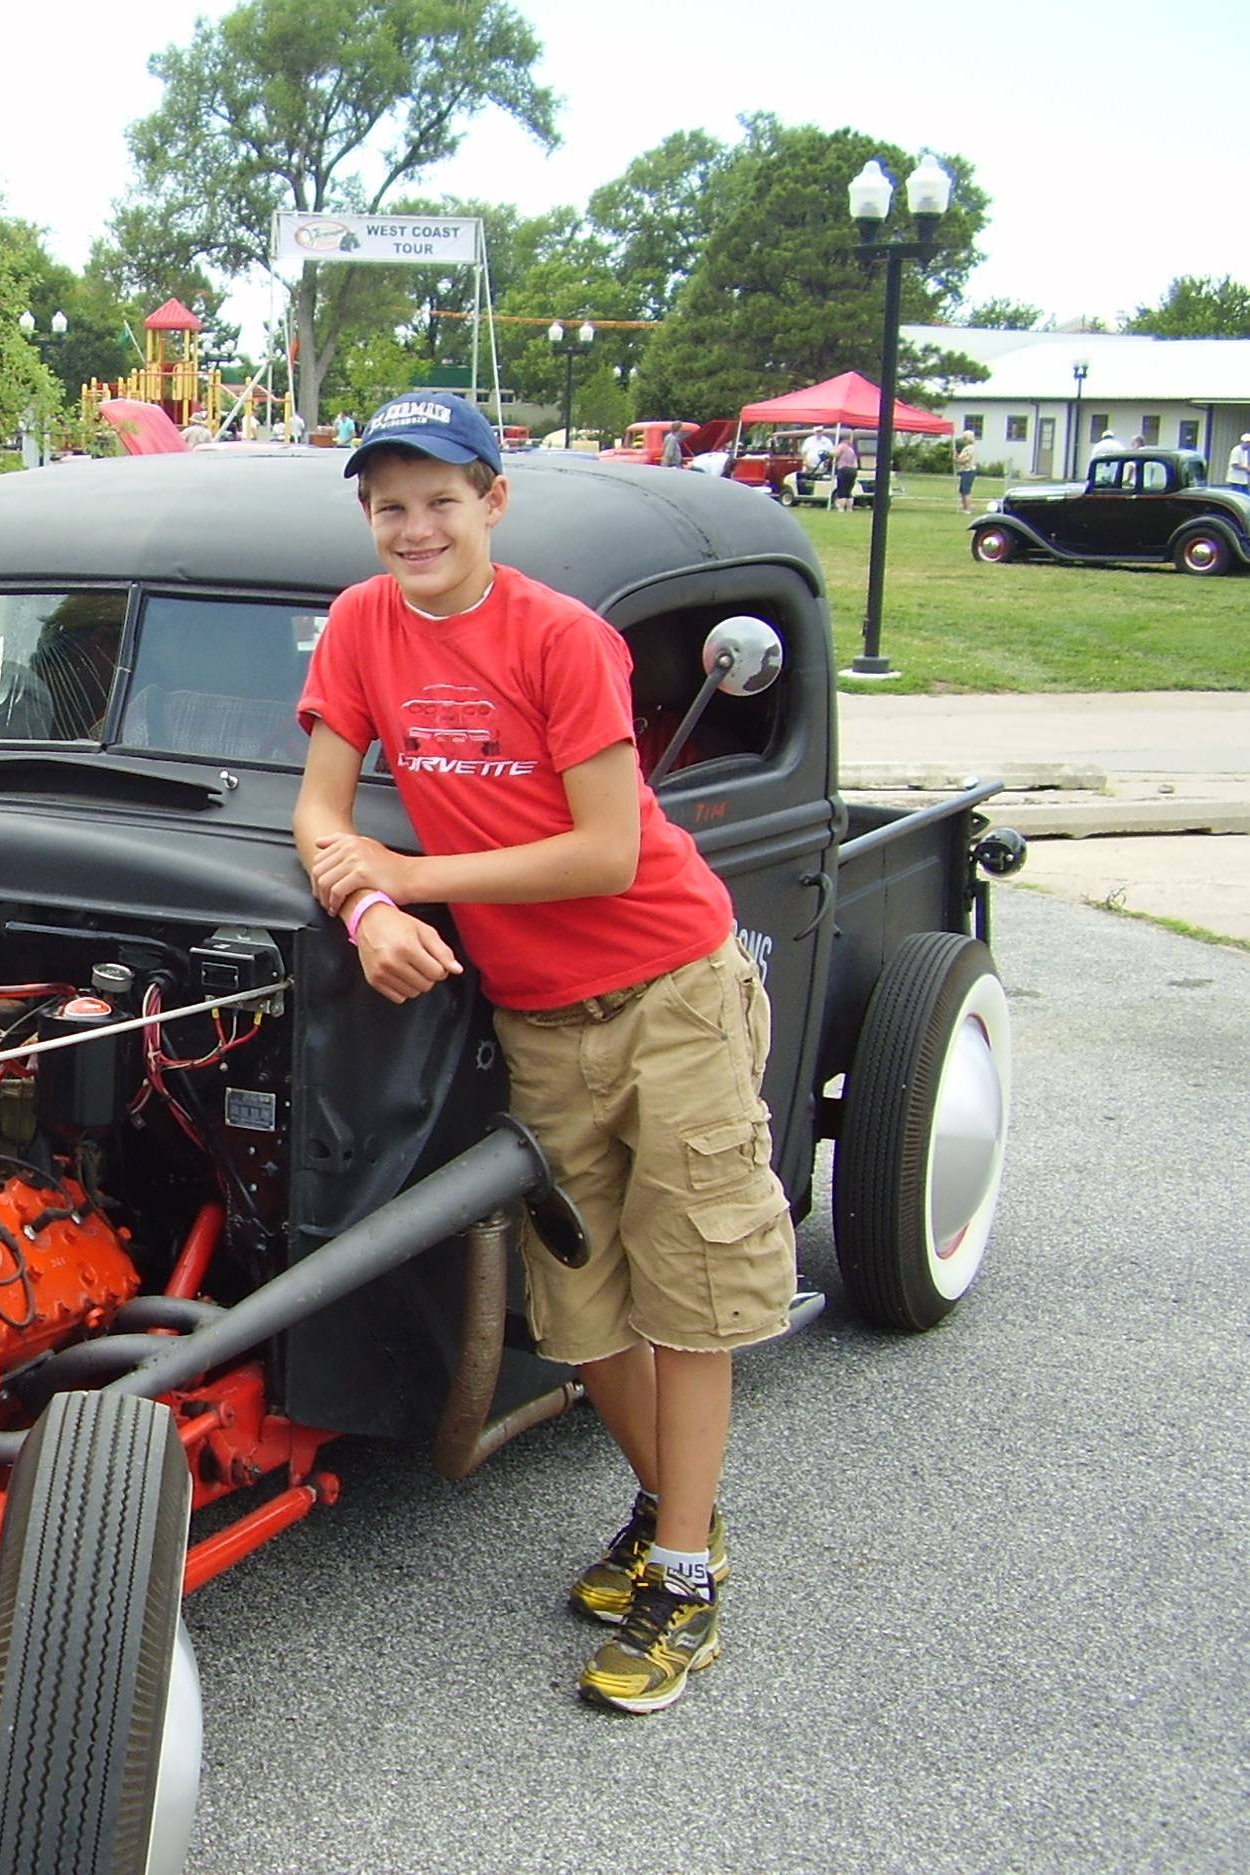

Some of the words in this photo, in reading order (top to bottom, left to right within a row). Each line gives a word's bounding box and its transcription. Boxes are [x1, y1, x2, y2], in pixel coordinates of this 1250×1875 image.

[366, 224, 407, 237] WEST
[412, 226, 460, 239] COAST
[393, 242, 434, 255] TOUR
